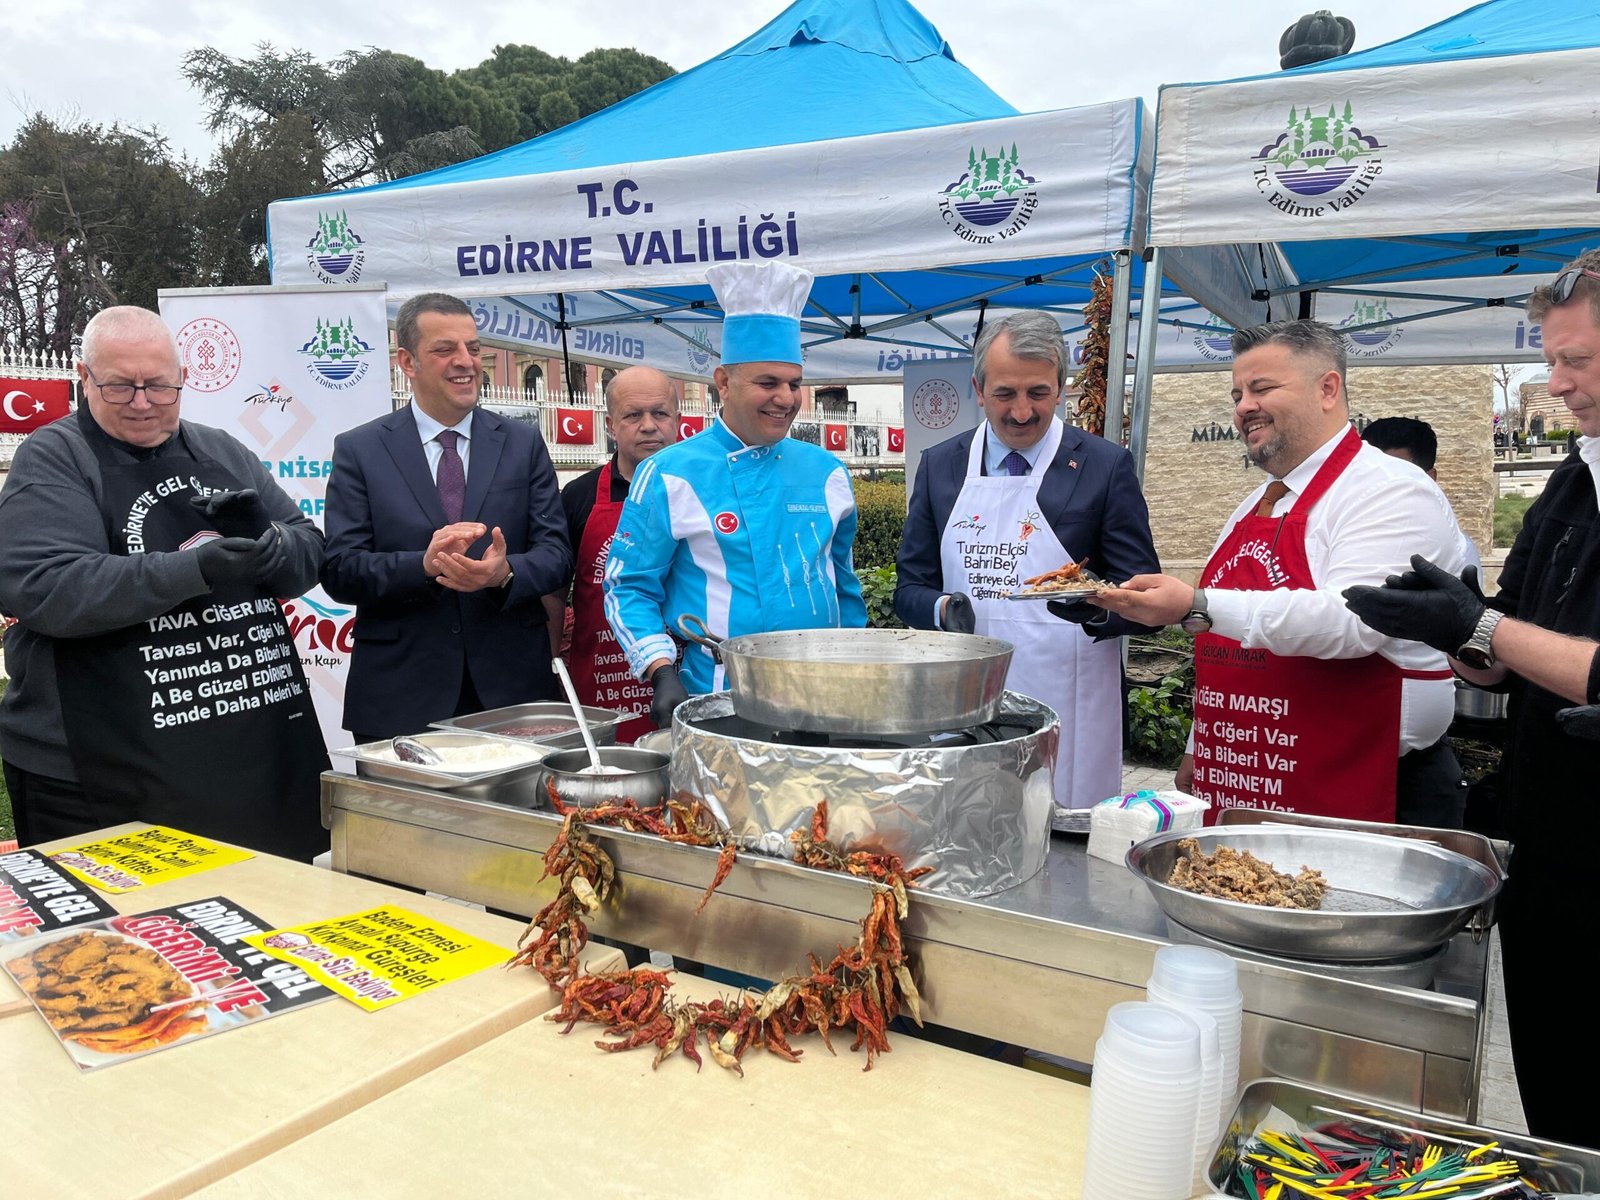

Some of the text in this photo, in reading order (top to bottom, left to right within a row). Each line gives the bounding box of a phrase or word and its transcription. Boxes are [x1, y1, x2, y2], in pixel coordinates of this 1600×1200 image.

[577, 179, 653, 218] T.C.
[1268, 191, 1325, 217] Edirne
[1327, 158, 1382, 212] Valiliği
[953, 223, 995, 244] Edirne
[998, 191, 1039, 240] Valiliği
[457, 211, 799, 277] EDİRNE VALİLİĞİ
[244, 393, 293, 412] Türkiye
[122, 491, 159, 554] EDİRNE'YE
[156, 476, 188, 498] GEL
[291, 499, 325, 515] AF
[956, 541, 1028, 559] Turizm Elçisi
[964, 556, 1018, 574] Bahri Bey
[145, 612, 198, 633] TAVA
[202, 602, 253, 624] CİĞER
[139, 641, 201, 662] Tavası
[206, 631, 245, 651] Var,
[315, 654, 342, 669] Kapı
[144, 660, 222, 685] Yanında
[227, 654, 252, 670] Da
[594, 668, 636, 684] Yanınd
[151, 692, 165, 708] A
[169, 688, 193, 704] Be
[198, 674, 248, 698] Güzel
[153, 705, 211, 729] Sende
[215, 695, 261, 716] Daha
[263, 684, 291, 705] Neleri
[596, 685, 654, 702] A Be Güze
[1229, 694, 1289, 720] MARŞI
[1213, 721, 1258, 743] Ciğeri
[1264, 728, 1298, 747] Var
[1215, 746, 1258, 768] Biberi
[1264, 753, 1298, 772] Var
[1209, 767, 1282, 795] EDİRNE'M
[1216, 790, 1258, 809] Neleri
[111, 853, 169, 875] Köftesi
[44, 895, 100, 923] GEL
[363, 910, 472, 955] Badem Ezmesi
[376, 932, 440, 965] Süpürge
[124, 915, 271, 1014] CİĞERİMİ VE
[262, 961, 322, 999] GEL
[322, 957, 361, 981] Sizi
[365, 949, 446, 989] Güreşleri
[340, 968, 400, 1002] Bekliyor
